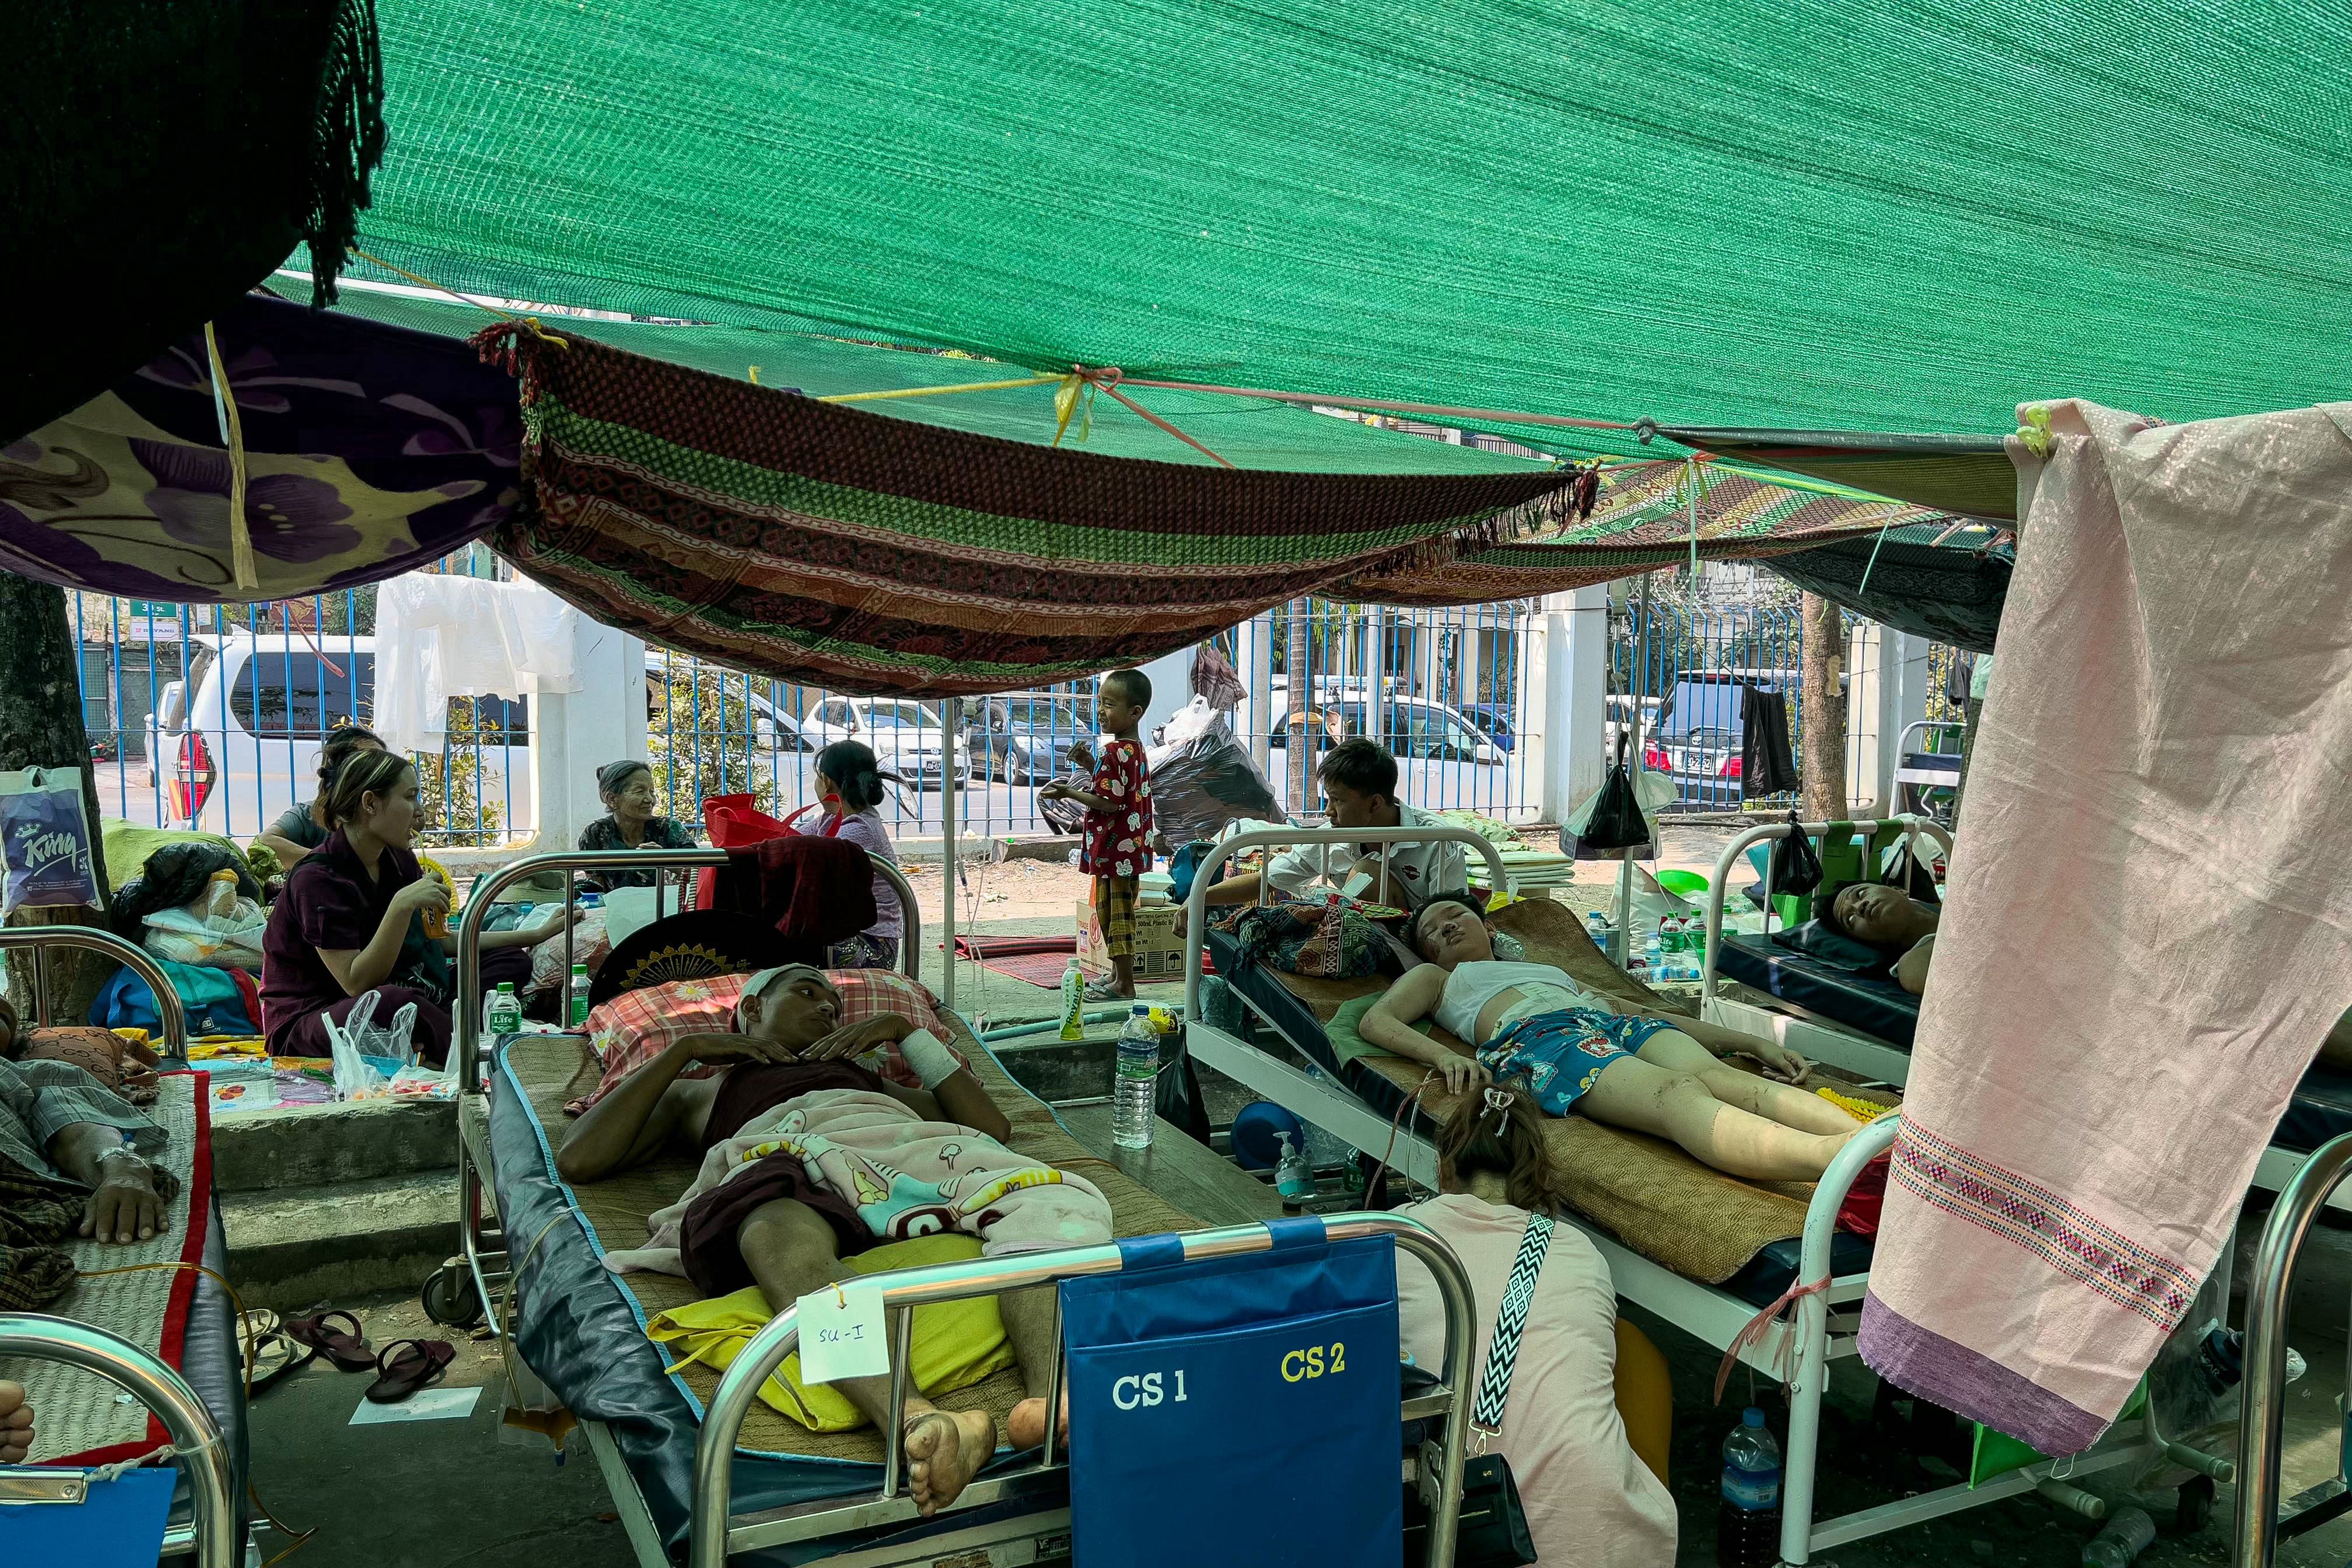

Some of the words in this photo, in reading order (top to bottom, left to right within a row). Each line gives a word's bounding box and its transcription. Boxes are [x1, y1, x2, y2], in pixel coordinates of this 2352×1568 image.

[22, 831, 76, 873] King
[428, 905, 436, 927] SPEE
[494, 1014, 513, 1023] Life
[1281, 1345, 1325, 1382] CS
[1330, 1342, 1345, 1374] 2
[1112, 1371, 1164, 1410] CS
[1174, 1369, 1187, 1402] 1
